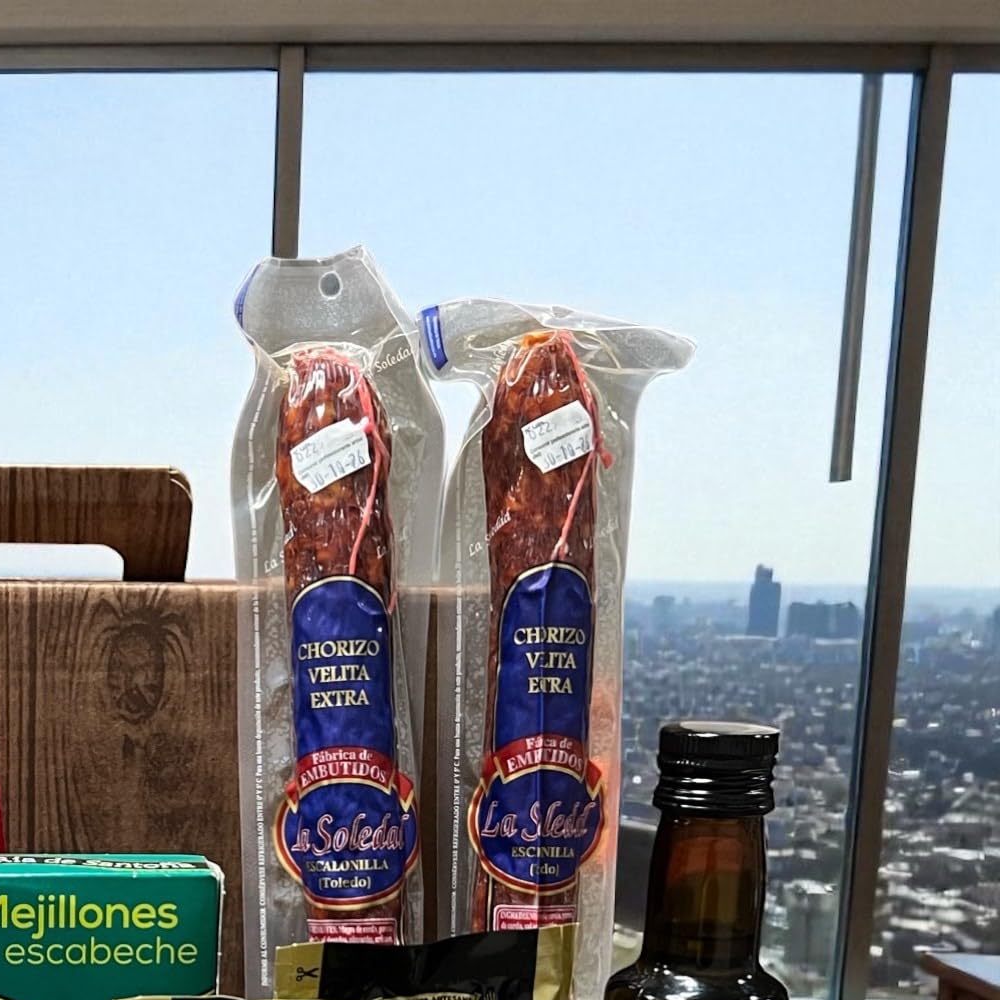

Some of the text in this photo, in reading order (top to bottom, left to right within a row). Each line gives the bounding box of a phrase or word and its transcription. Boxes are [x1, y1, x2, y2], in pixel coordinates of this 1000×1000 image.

[298, 640, 380, 660] CHORIZO
[526, 651, 576, 669] VITA
[308, 664, 370, 684] VELITA
[310, 689, 370, 709] EXTRA
[559, 738, 572, 749] de
[312, 749, 373, 765] Fábrica de
[300, 762, 386, 787] EMBUTIDOS
[481, 800, 518, 837] La
[319, 877, 371, 889] (Toledo)
[5, 936, 198, 965] escabeche
